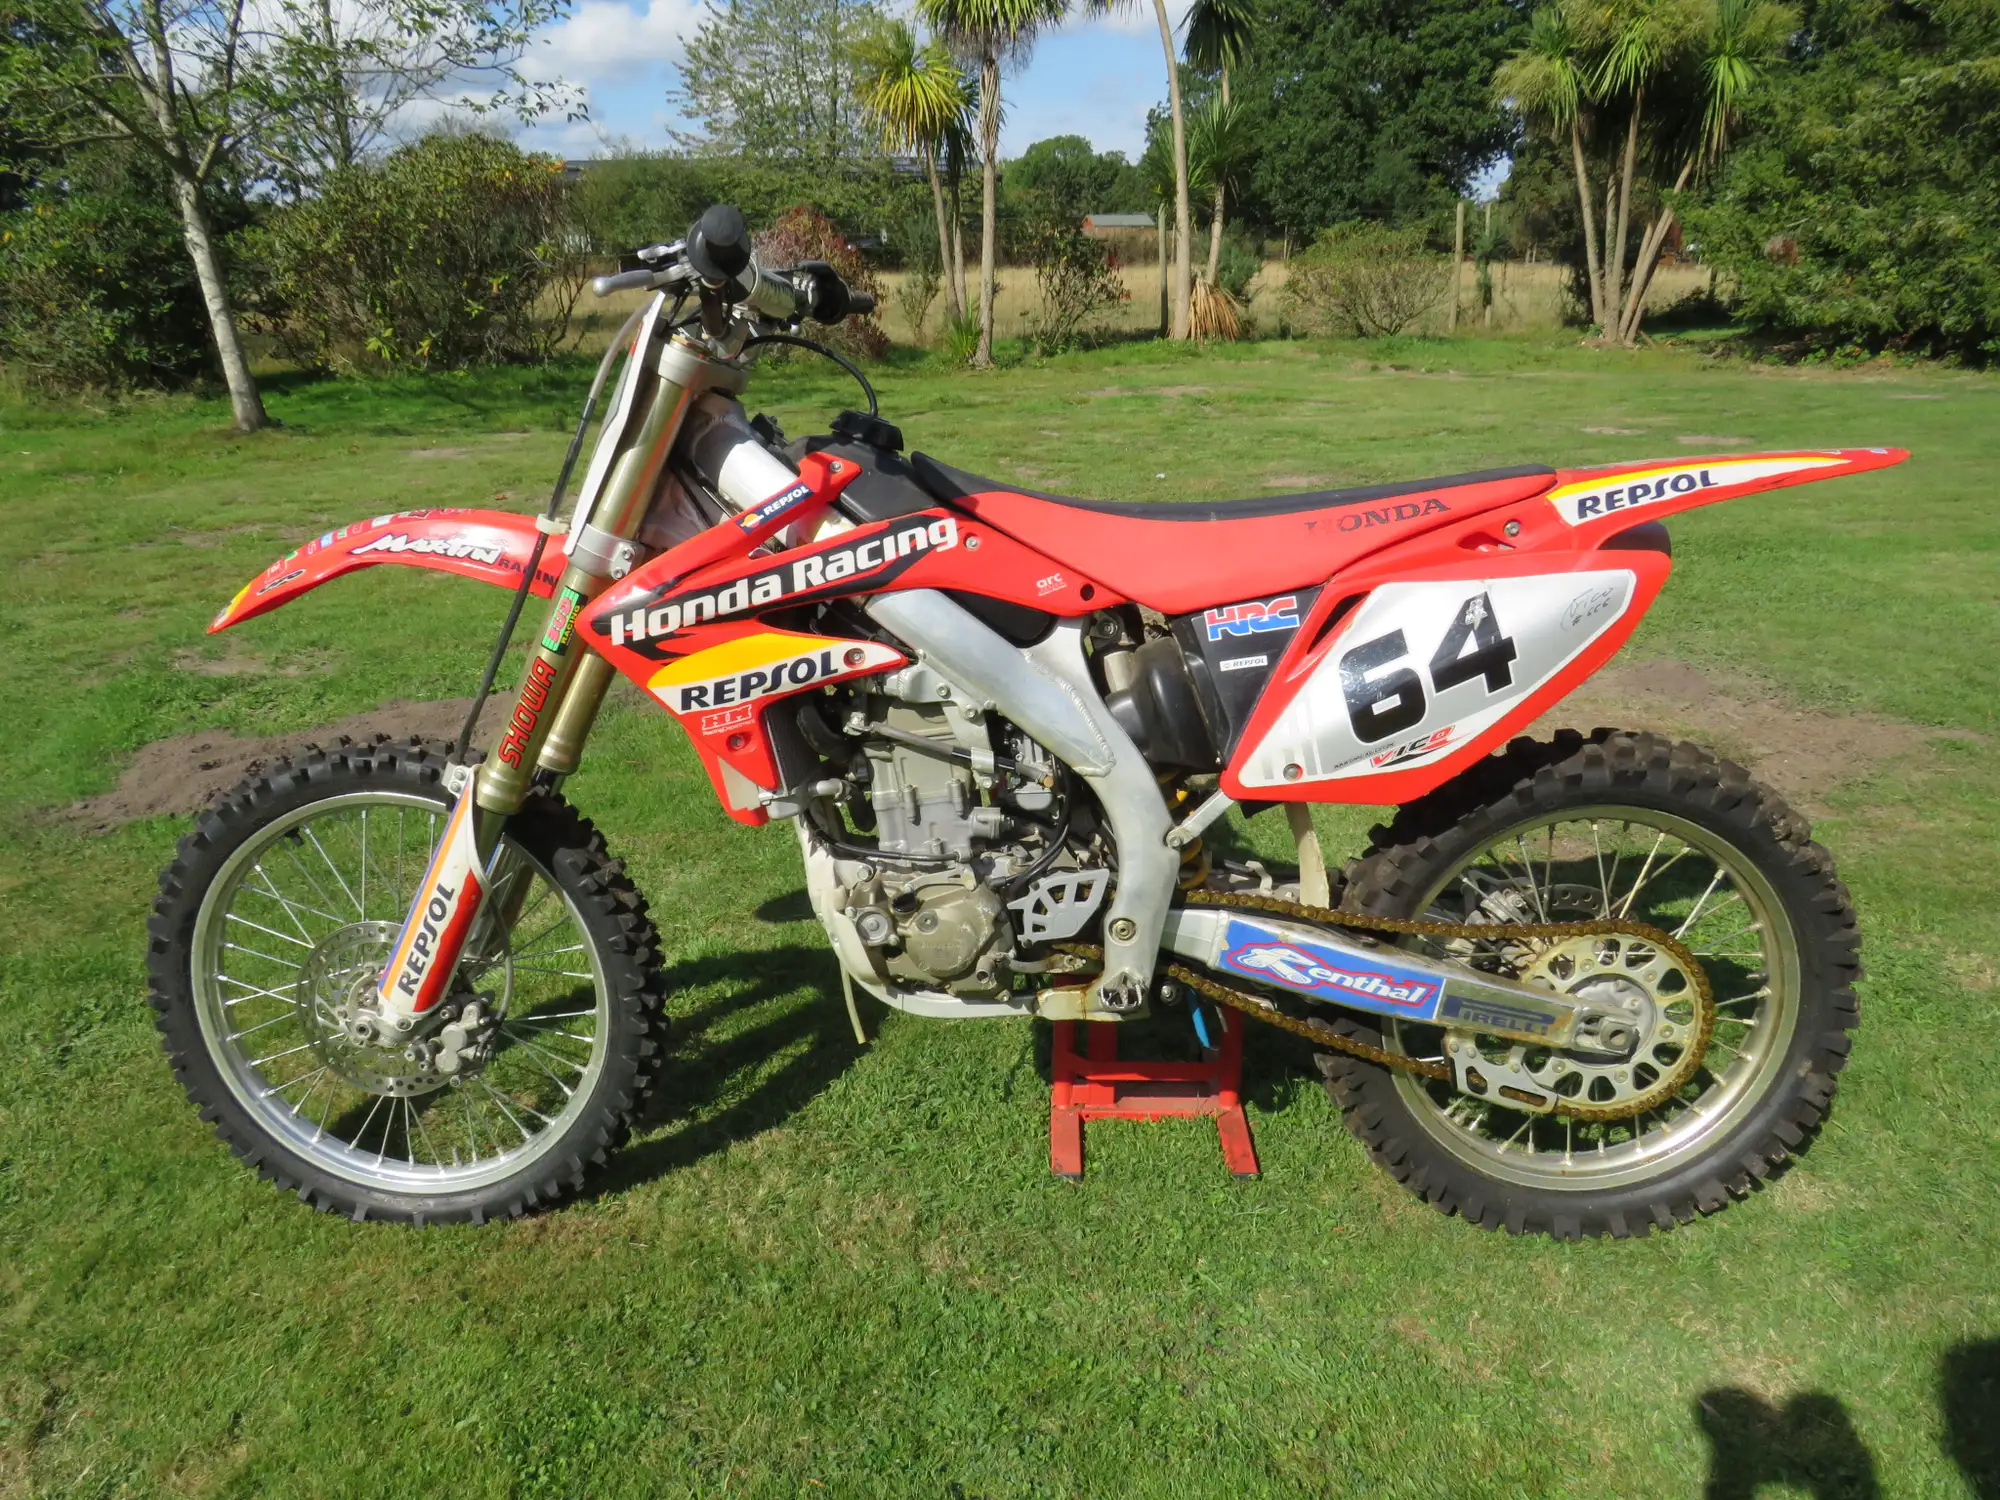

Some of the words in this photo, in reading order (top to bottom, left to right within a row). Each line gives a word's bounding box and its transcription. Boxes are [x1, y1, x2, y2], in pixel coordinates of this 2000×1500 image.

[763, 485, 809, 515] REPSOL
[1577, 470, 1718, 519] REPSOL
[611, 573, 782, 645] Honda
[793, 518, 958, 592] Racing
[548, 597, 573, 643] BUD
[561, 605, 581, 645] RACING
[1204, 596, 1299, 641] HRC
[681, 652, 838, 711] REPSOL
[1232, 658, 1266, 668] REPSOL
[1339, 591, 1517, 743] 64
[498, 656, 557, 769] SHOWA
[397, 883, 455, 997] REPSOL
